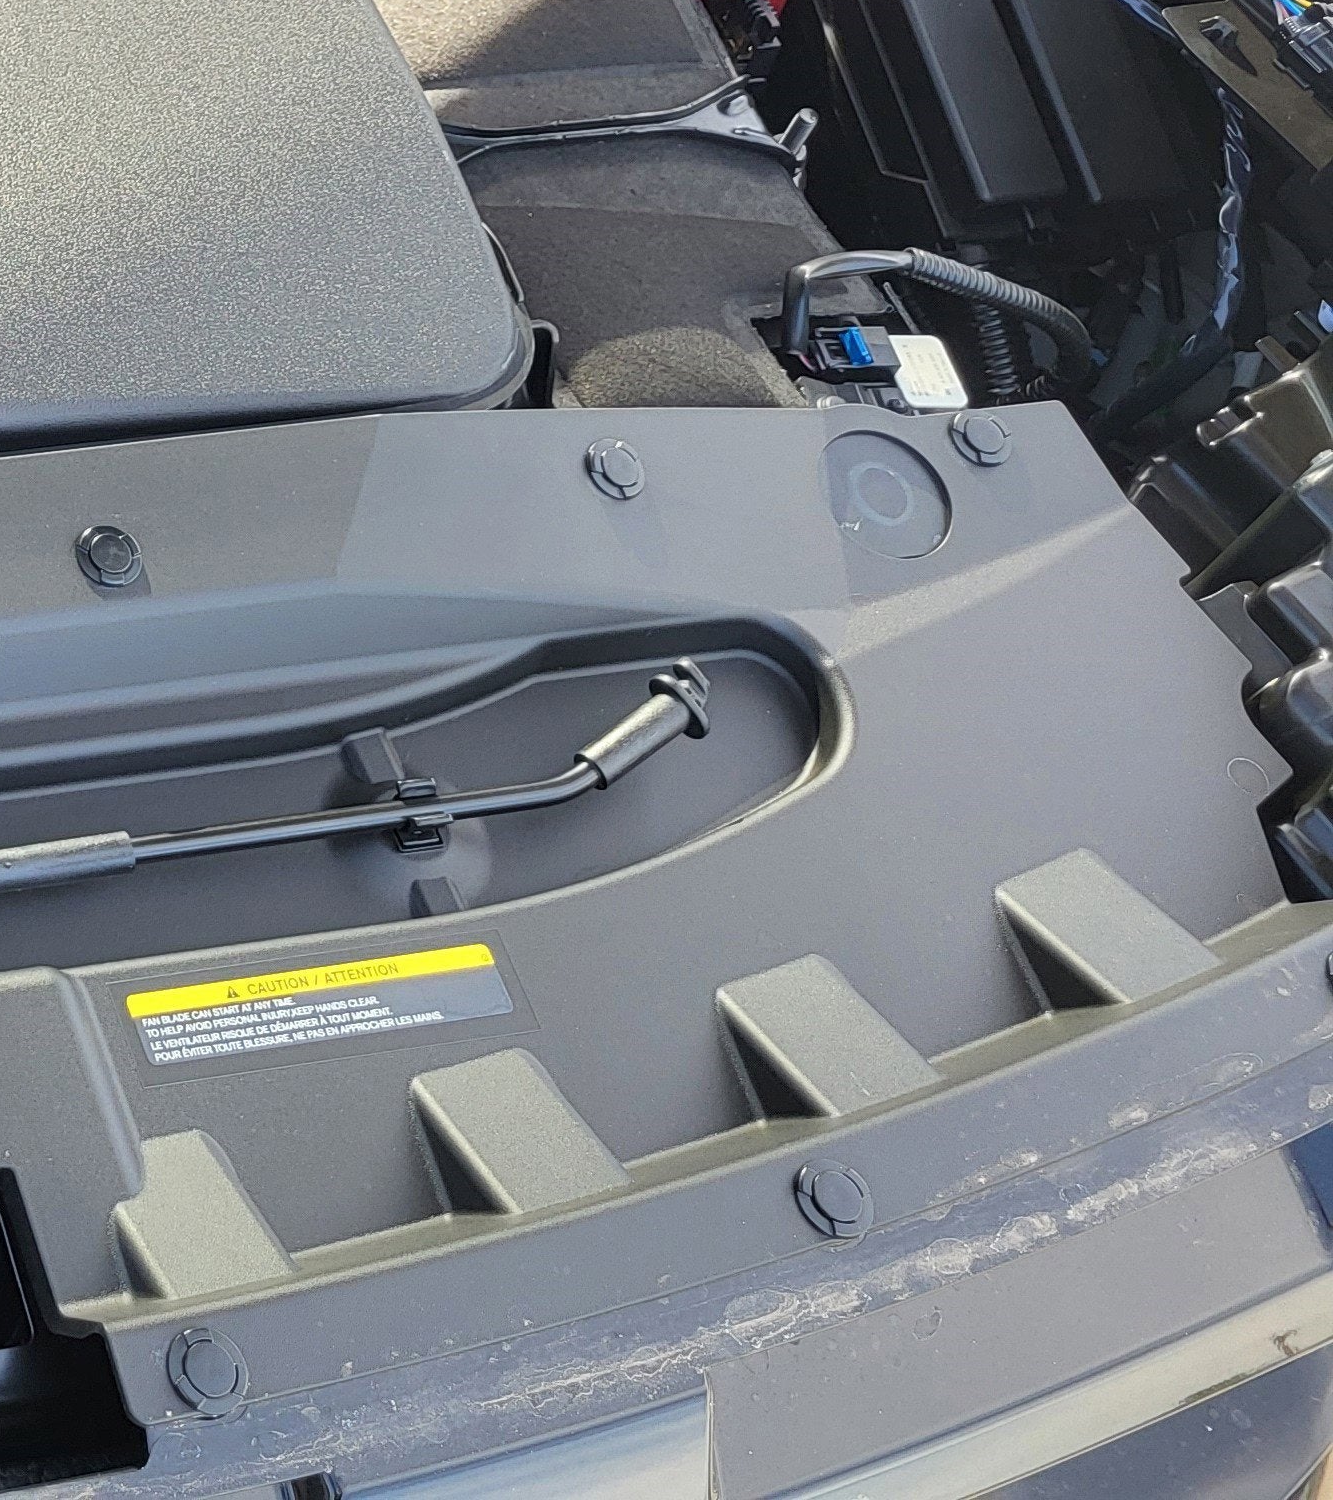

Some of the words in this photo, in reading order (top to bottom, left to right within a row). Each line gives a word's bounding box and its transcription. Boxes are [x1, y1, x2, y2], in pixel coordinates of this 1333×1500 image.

[247, 976, 308, 993] CAUTION
[324, 963, 398, 982] ATTENTION
[142, 1017, 159, 1026] FAN
[161, 1012, 190, 1023] BLADE
[192, 1009, 211, 1019] CAN
[213, 1005, 240, 1016] START
[241, 1003, 252, 1011] AT
[253, 1001, 271, 1010] ANY
[273, 997, 295, 1006] TIME.
[147, 1029, 159, 1037] TO
[160, 1025, 183, 1035] HELP
[185, 1021, 212, 1031] AVOID
[214, 1014, 260, 1027] PERSONAL
[316, 1001, 346, 1011] HANDS
[348, 996, 379, 1007] CLEAR.
[151, 1041, 162, 1049] LE
[163, 1033, 220, 1047] VENTILATEUR
[222, 1028, 255, 1039] RISQUE
[256, 1025, 269, 1033] DE
[270, 1016, 318, 1031] DÉMARRER
[319, 1014, 326, 1024] À
[328, 1013, 351, 1023] TOUT
[352, 1007, 392, 1019] MOMENT.
[155, 1050, 181, 1061] POUR
[182, 1044, 212, 1056] ÉVITER
[214, 1041, 243, 1052] TOUTE
[244, 1034, 292, 1047] BLESSURE,
[293, 1032, 306, 1040] NE
[308, 1029, 324, 1037] PAS
[340, 1018, 396, 1032] APPROCHER
[396, 1016, 412, 1024] LES
[413, 1011, 443, 1021] MAINS.
